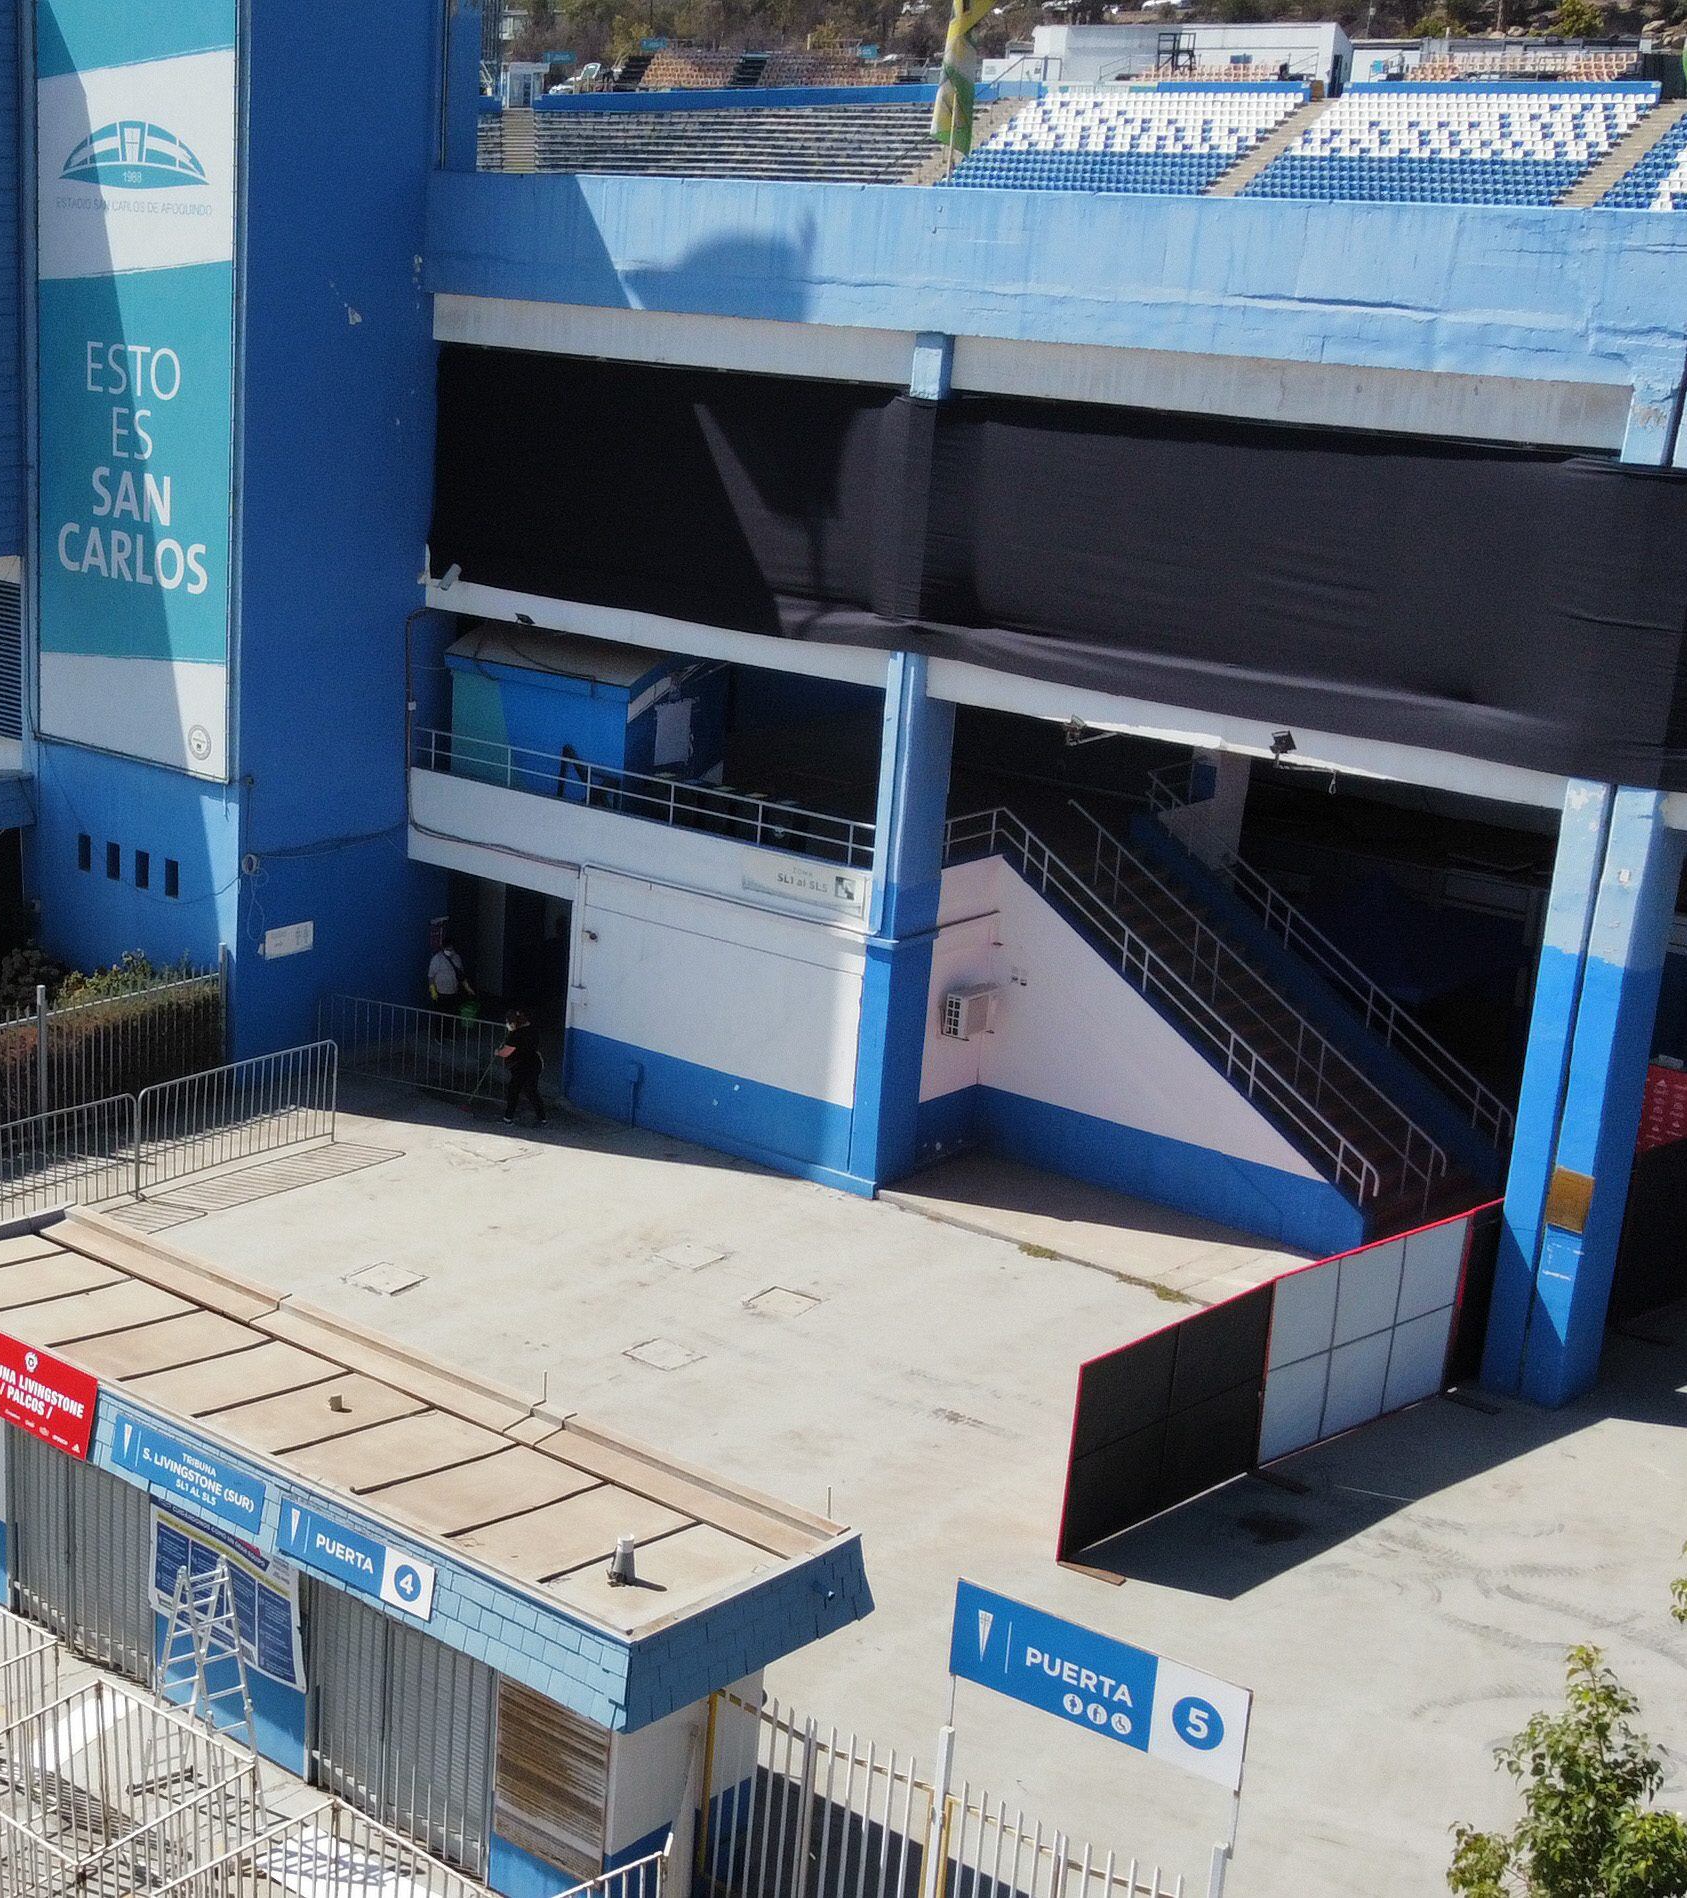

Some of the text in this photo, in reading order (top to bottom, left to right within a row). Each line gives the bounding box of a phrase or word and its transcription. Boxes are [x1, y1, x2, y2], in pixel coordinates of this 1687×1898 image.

[86, 341, 181, 400] ESTO
[112, 406, 153, 460] ES
[92, 466, 171, 527] SAN
[58, 522, 208, 595] CARLOS
[7, 1385, 45, 1416] PALCOS
[18, 1375, 84, 1419] LIVINGSTONE
[142, 1447, 255, 1513] S. LIVINGSTONE (SUR)
[175, 1479, 217, 1506] SL1 AL SL5
[182, 1453, 217, 1477] TRIBUNA
[316, 1533, 374, 1574] PUERTA
[399, 1574, 414, 1595] 4
[1026, 1646, 1209, 1739] PUERTA 5
